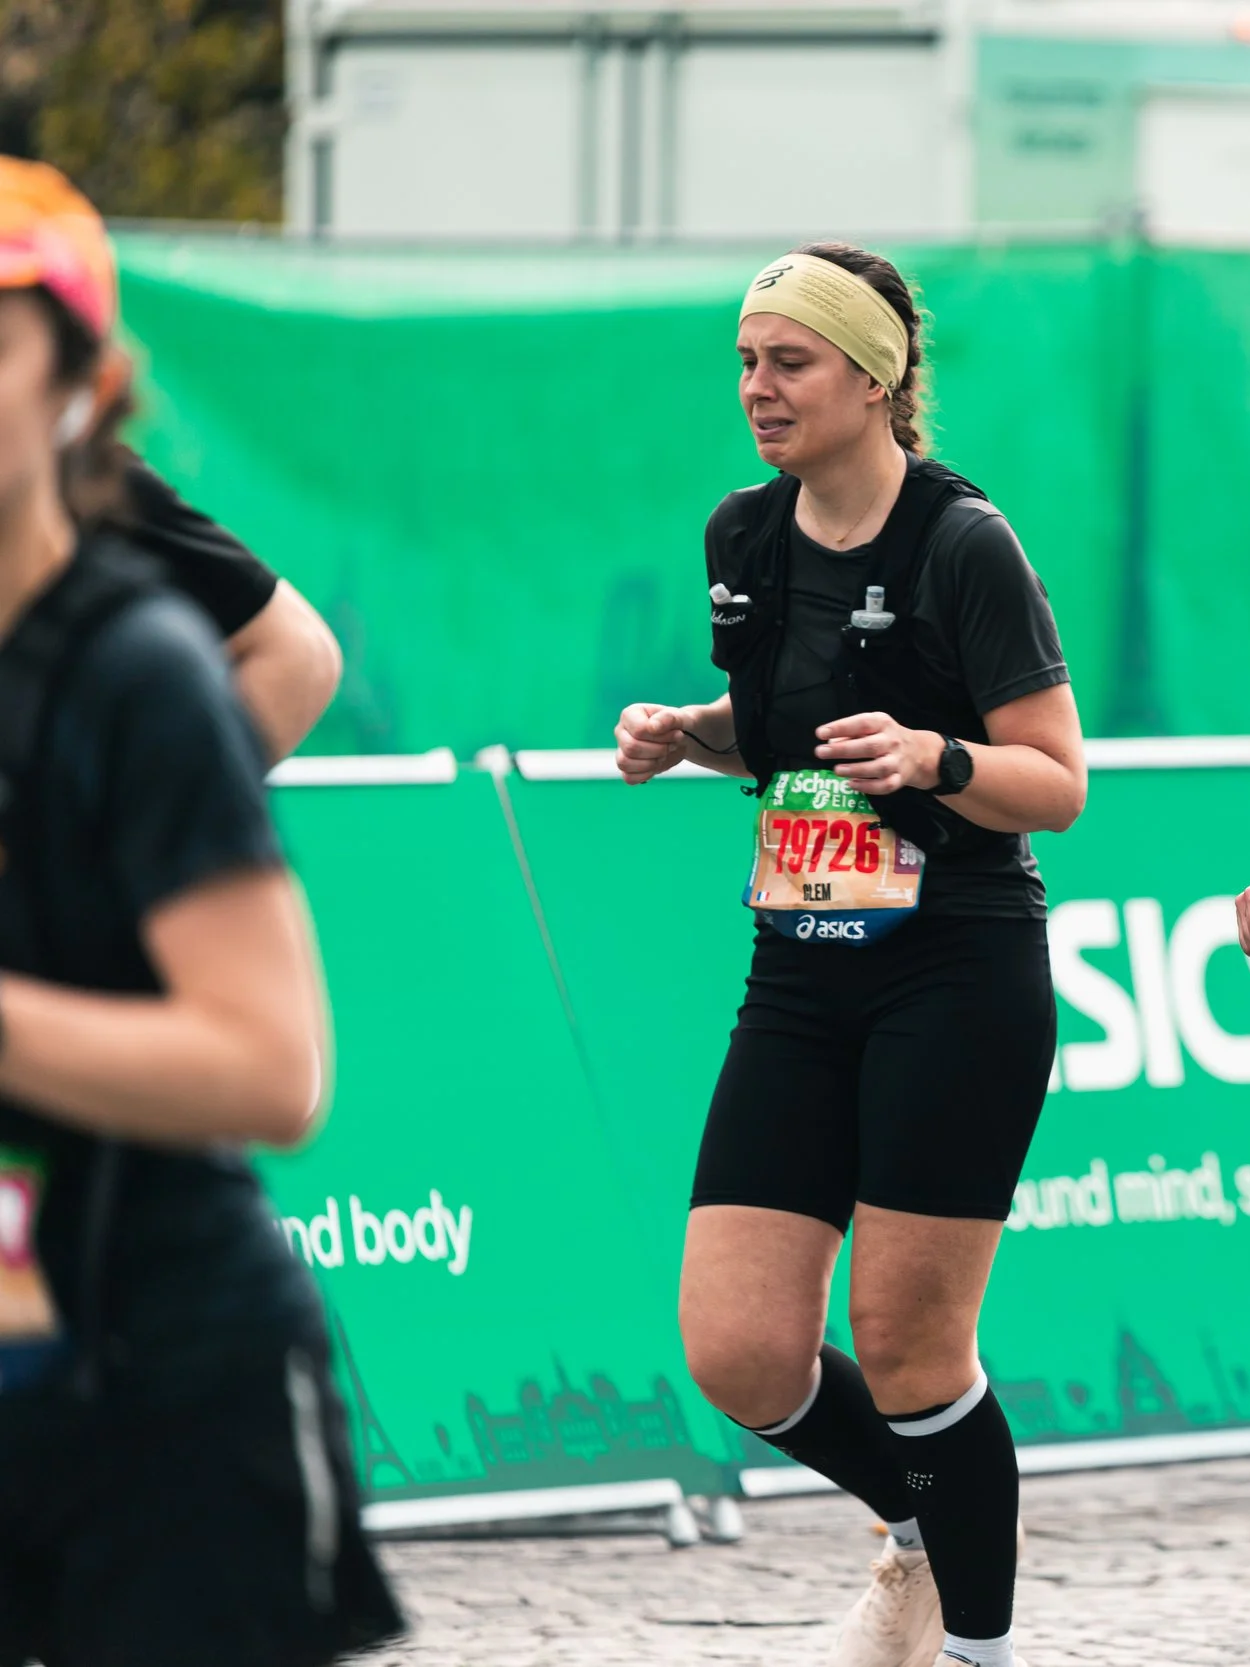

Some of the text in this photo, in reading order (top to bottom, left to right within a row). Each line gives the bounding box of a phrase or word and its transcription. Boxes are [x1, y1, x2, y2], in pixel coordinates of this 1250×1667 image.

[791, 772, 864, 795] Schne
[832, 795, 873, 810] Elec
[772, 818, 881, 874] 79726
[1006, 1157, 1114, 1231] ound
[349, 1187, 473, 1276] body
